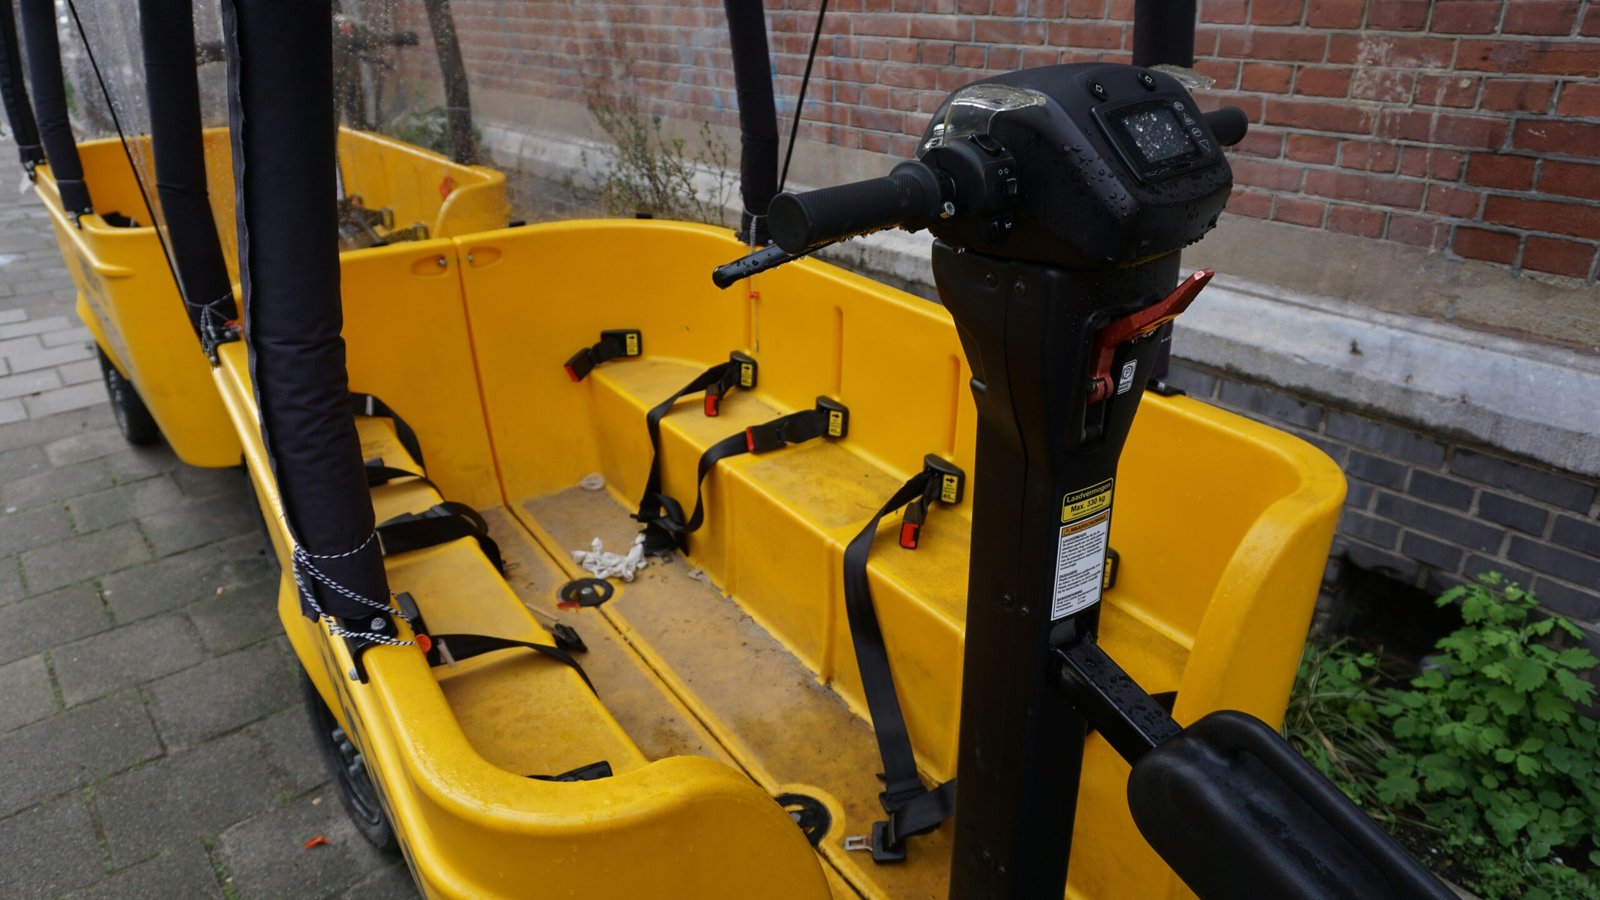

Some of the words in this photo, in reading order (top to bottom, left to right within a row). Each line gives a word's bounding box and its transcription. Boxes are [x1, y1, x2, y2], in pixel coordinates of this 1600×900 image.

[1066, 483, 1111, 503] Laadvermogen
[1071, 504, 1086, 513] Max.
[1087, 497, 1097, 507] 330
[1098, 495, 1106, 503] kg
